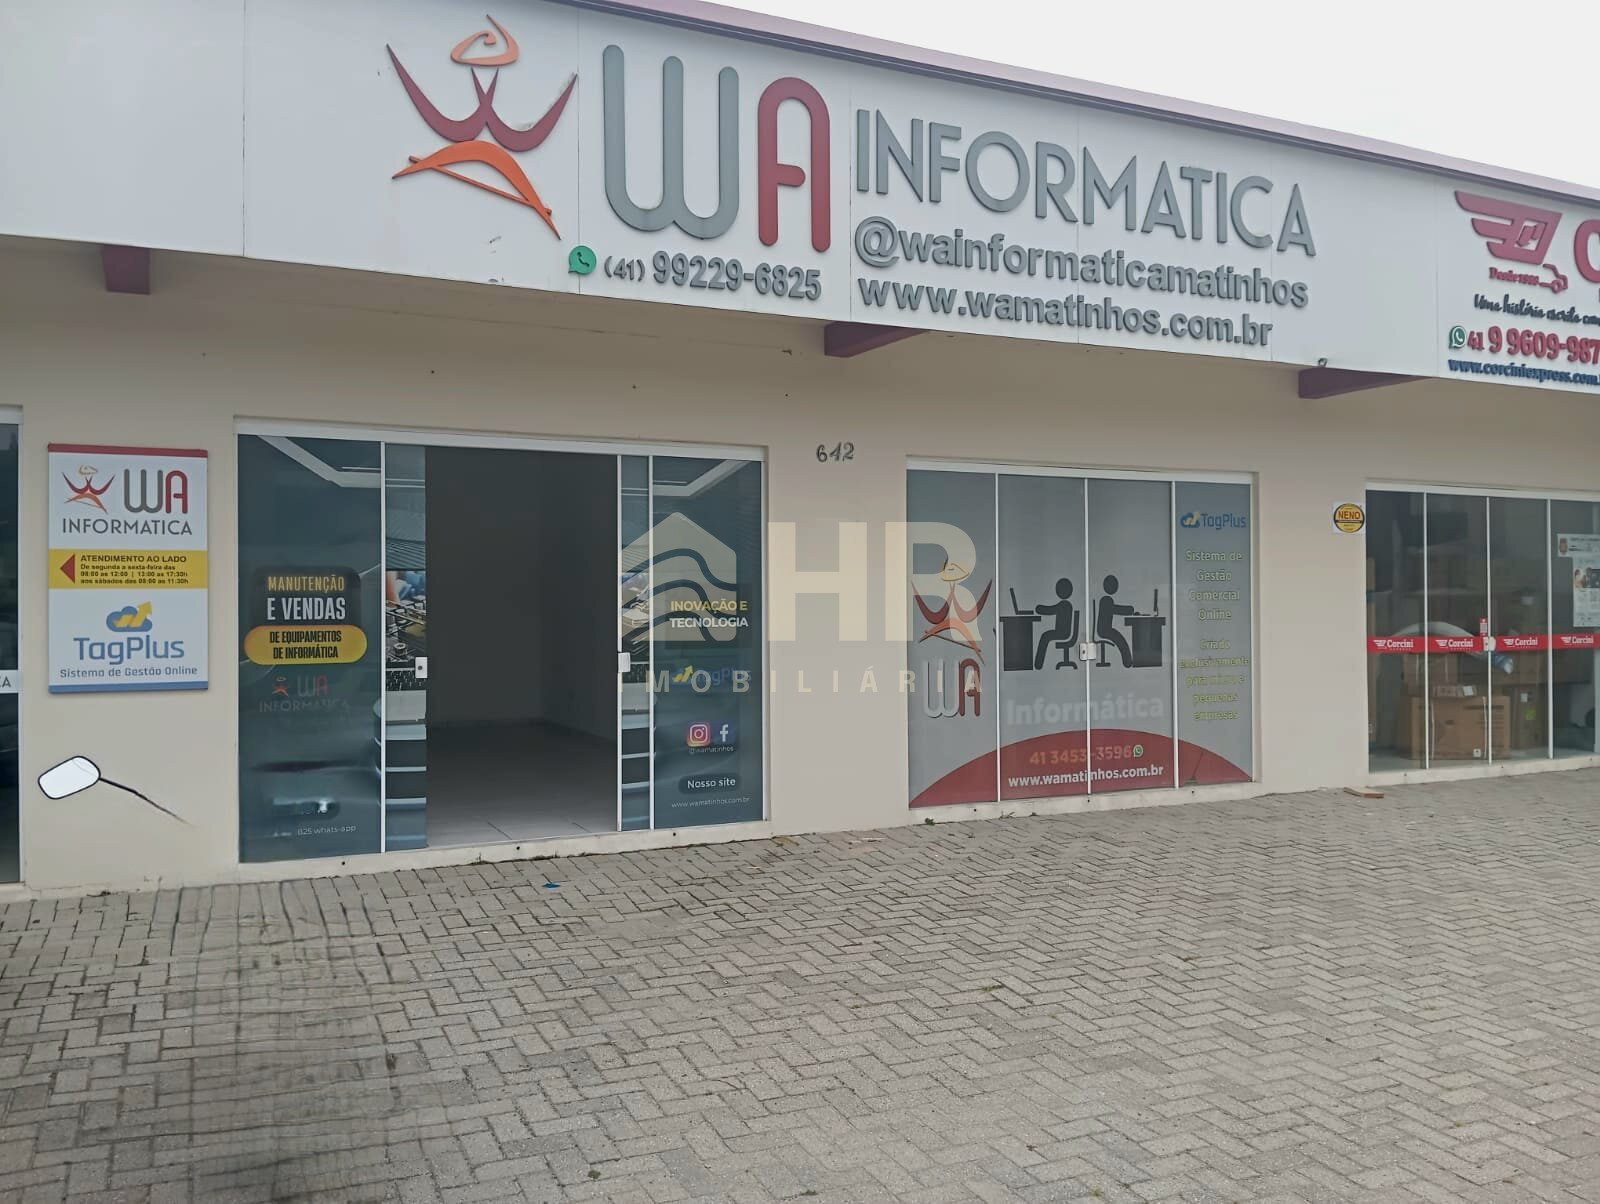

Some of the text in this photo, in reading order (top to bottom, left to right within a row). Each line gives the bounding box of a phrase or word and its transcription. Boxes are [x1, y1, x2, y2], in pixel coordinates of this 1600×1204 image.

[603, 44, 831, 252] WA
[856, 108, 1316, 257] INFORMATICA
[854, 215, 1309, 310] @wainformaticamatinhos
[603, 250, 823, 301] (41) 99229-6825
[858, 277, 1273, 347] www.wamatinhos.com.br
[1467, 330, 1485, 351] 41
[1488, 325, 1503, 354] 9
[1448, 358, 1600, 386] www.corciniexpress.com.
[816, 441, 855, 463] 642
[123, 468, 189, 515] WA
[1200, 512, 1247, 530] TagPlus
[1338, 511, 1361, 520] NENO
[62, 518, 193, 536] INFORMATICA
[80, 554, 187, 564] ATENDIMENTO AO LADO
[1185, 550, 1242, 561] Sistema de
[267, 574, 345, 593] MANUTENÇÃO
[1197, 569, 1232, 581] Gestão
[1190, 589, 1240, 600] Comercial
[267, 597, 346, 621] E VENDAS
[670, 598, 748, 613] INOVAÇÃO E
[1198, 608, 1232, 620] Online
[669, 616, 749, 628] TECNOLOGIA
[269, 630, 342, 644] DE EQUIPAMENTOS
[1386, 639, 1414, 649] Corcini
[1447, 639, 1474, 648] Corcini
[73, 634, 185, 665] TagPlus
[273, 645, 339, 659] DE INFORMÁTICA
[60, 665, 198, 678] Sistema de Gestão Online
[923, 657, 982, 719] WA
[1006, 692, 1165, 726] Informática
[1029, 751, 1047, 765] 41
[687, 777, 736, 789] Nosso site
[1008, 764, 1165, 788] www.wamatinhos.com.br
